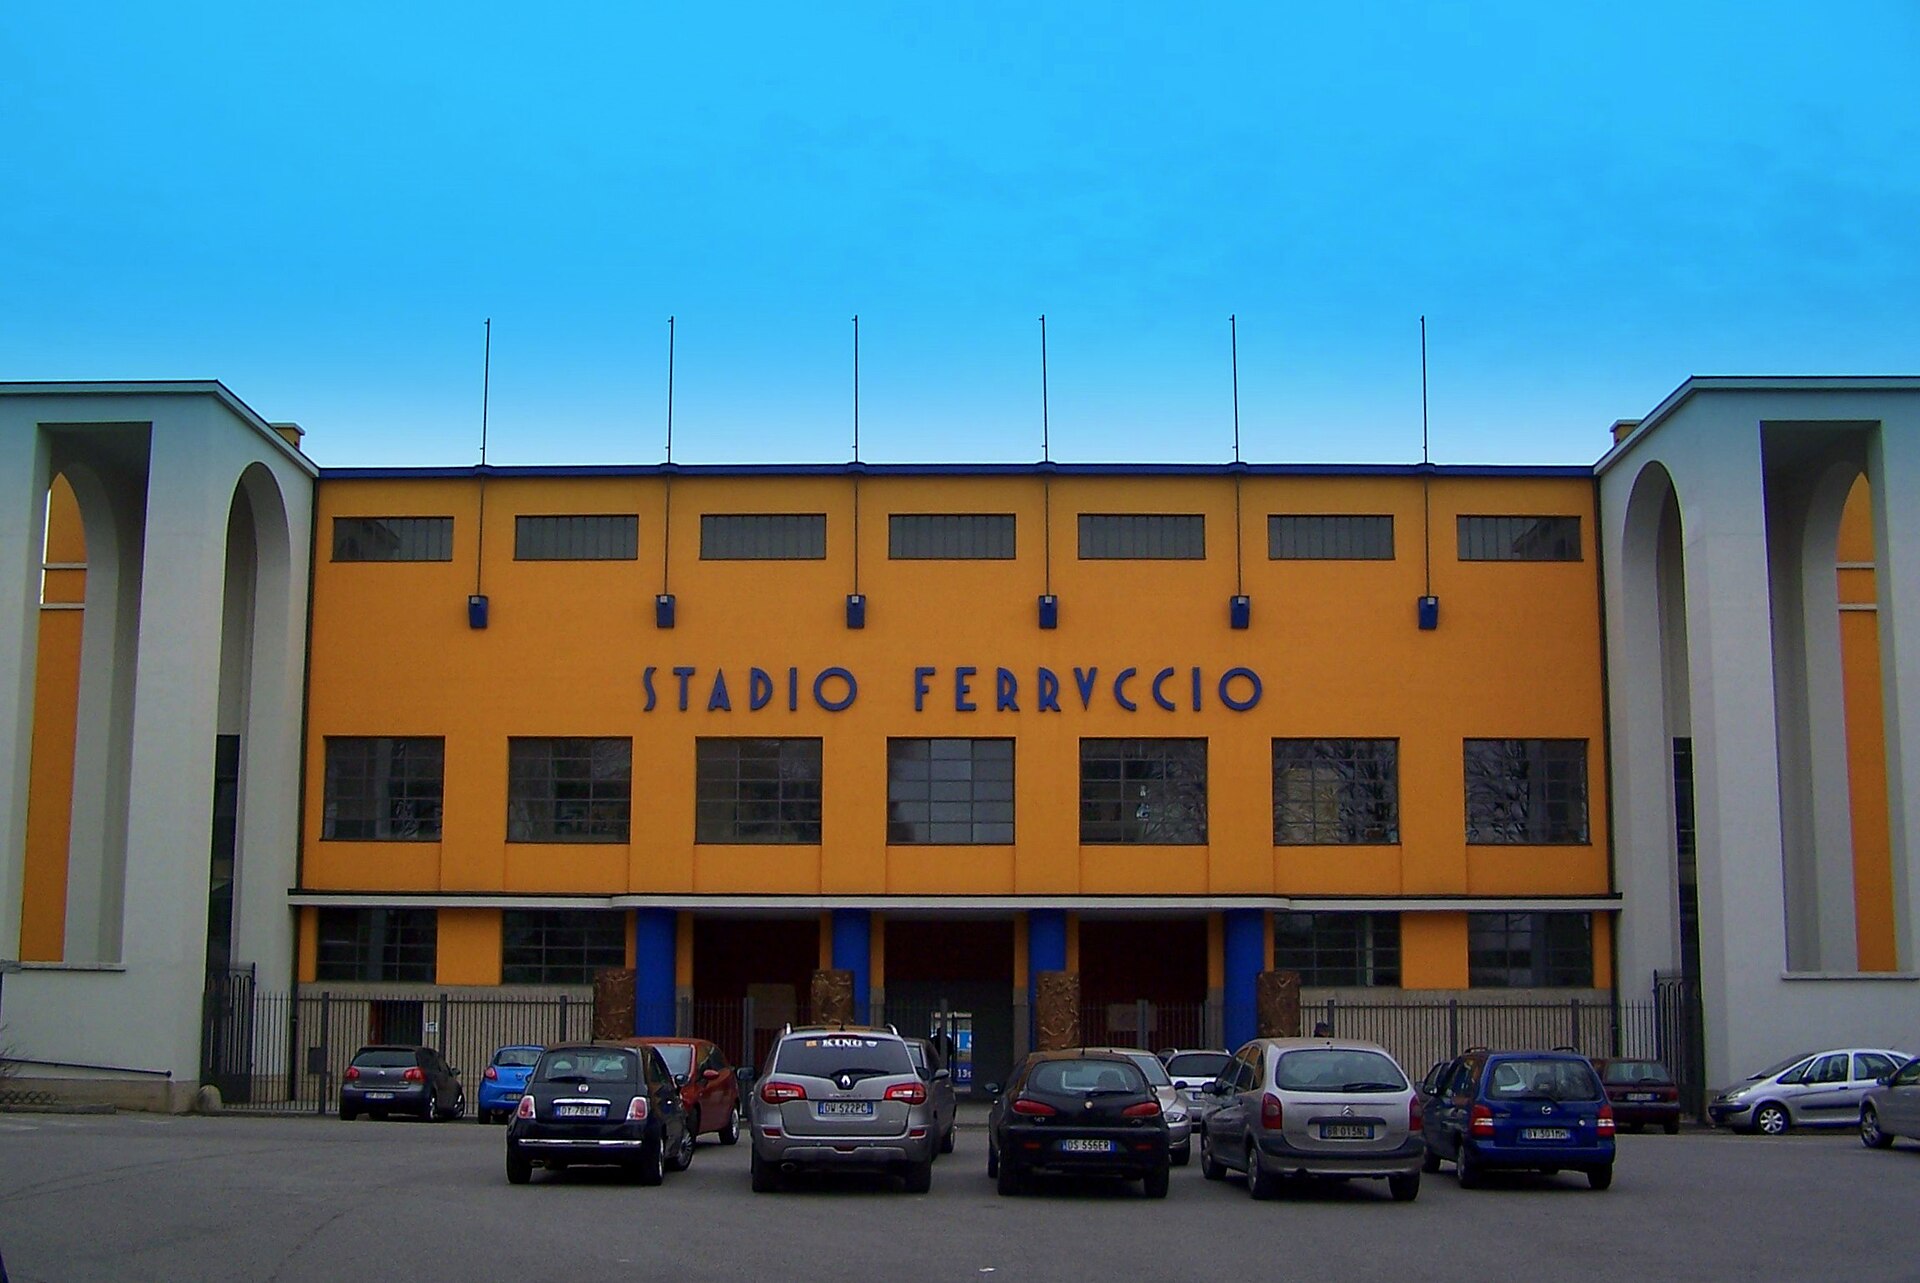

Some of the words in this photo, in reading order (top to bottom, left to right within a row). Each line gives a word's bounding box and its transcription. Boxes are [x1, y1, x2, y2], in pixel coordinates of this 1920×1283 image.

[644, 667, 857, 711] STADIO
[915, 667, 1262, 711] FERRVCCIO
[822, 1039, 862, 1047] KING
[825, 1102, 837, 1114] DW
[839, 1102, 867, 1114] 522PC
[1068, 1140, 1079, 1150] DS
